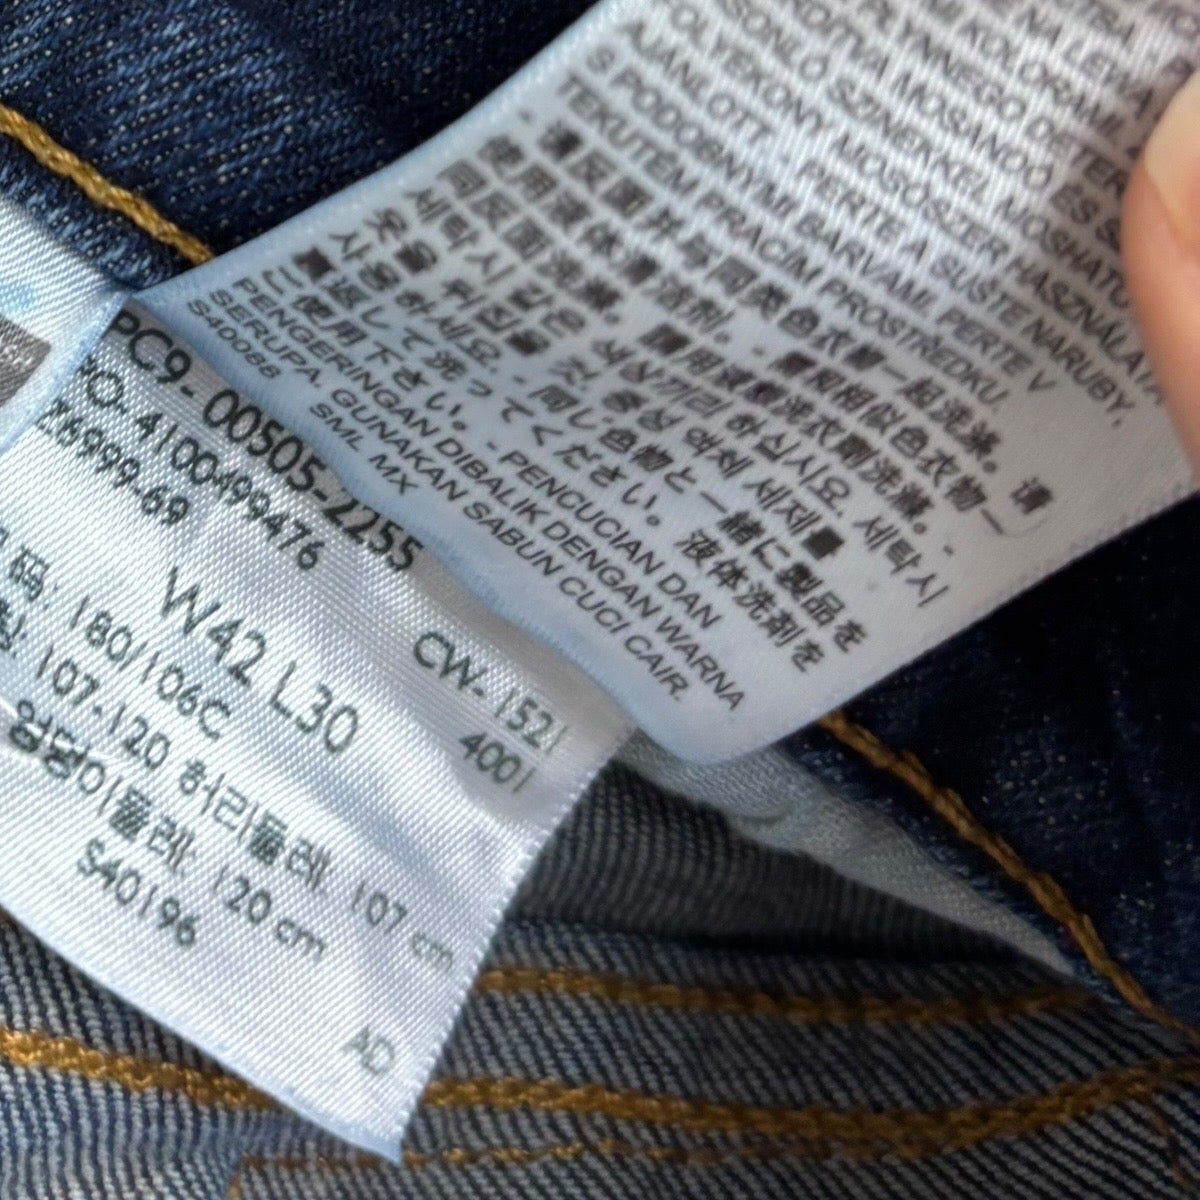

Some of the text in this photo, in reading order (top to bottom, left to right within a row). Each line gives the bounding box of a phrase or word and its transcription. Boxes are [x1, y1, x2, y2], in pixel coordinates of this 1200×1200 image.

[933, 305, 1033, 378] PERTE
[1025, 370, 1057, 392] V
[206, 287, 691, 702] SERUPA. GUNAKAN SABUN CUCI CAIR.
[229, 276, 739, 712] PENGERINGAN DIBALIK DENGAN WARNA
[307, 401, 363, 452] SML
[366, 453, 419, 496] MX
[497, 448, 667, 576] PENCUCIAN
[654, 572, 724, 630] DAN
[852, 512, 950, 607] 세탁시
[71, 595, 234, 742] 180/106C
[161, 565, 360, 752] W42 L30
[37, 645, 170, 771] 107-120
[350, 881, 410, 935] 107
[410, 928, 455, 973] cm
[462, 732, 535, 794] 4001
[74, 838, 198, 947] S40196
[214, 863, 271, 925] 120
[277, 919, 327, 963] cm
[340, 1023, 397, 1073] AD
